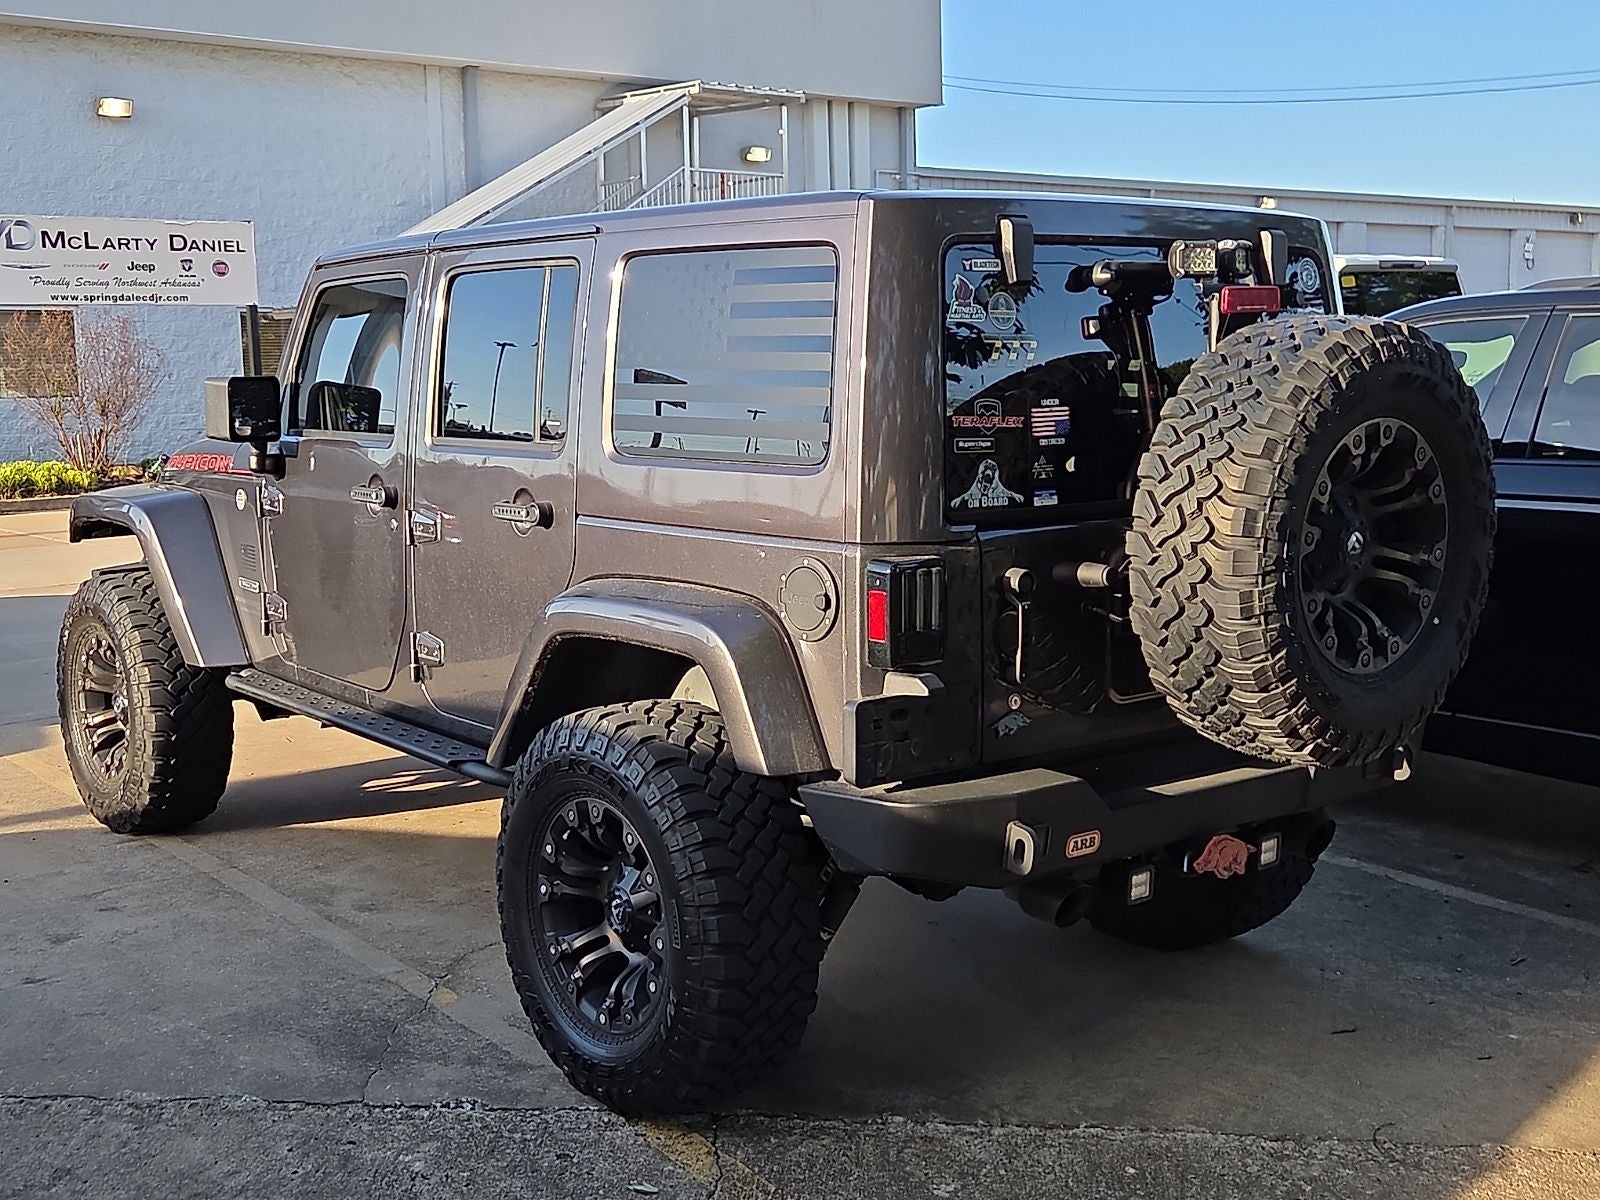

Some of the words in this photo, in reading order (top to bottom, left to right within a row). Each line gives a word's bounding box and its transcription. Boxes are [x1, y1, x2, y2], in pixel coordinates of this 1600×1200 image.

[168, 233, 247, 253] DANIEL
[126, 260, 156, 274] Jeep
[74, 276, 111, 290] Serving
[112, 276, 157, 288] Northwest
[50, 292, 189, 304] www.springdalecdjr.com
[952, 415, 1025, 428] TERAFLEX
[166, 452, 233, 472] RUBICON
[967, 498, 980, 509] ON
[981, 495, 1009, 508] BOARD
[1070, 836, 1097, 853] ARB
